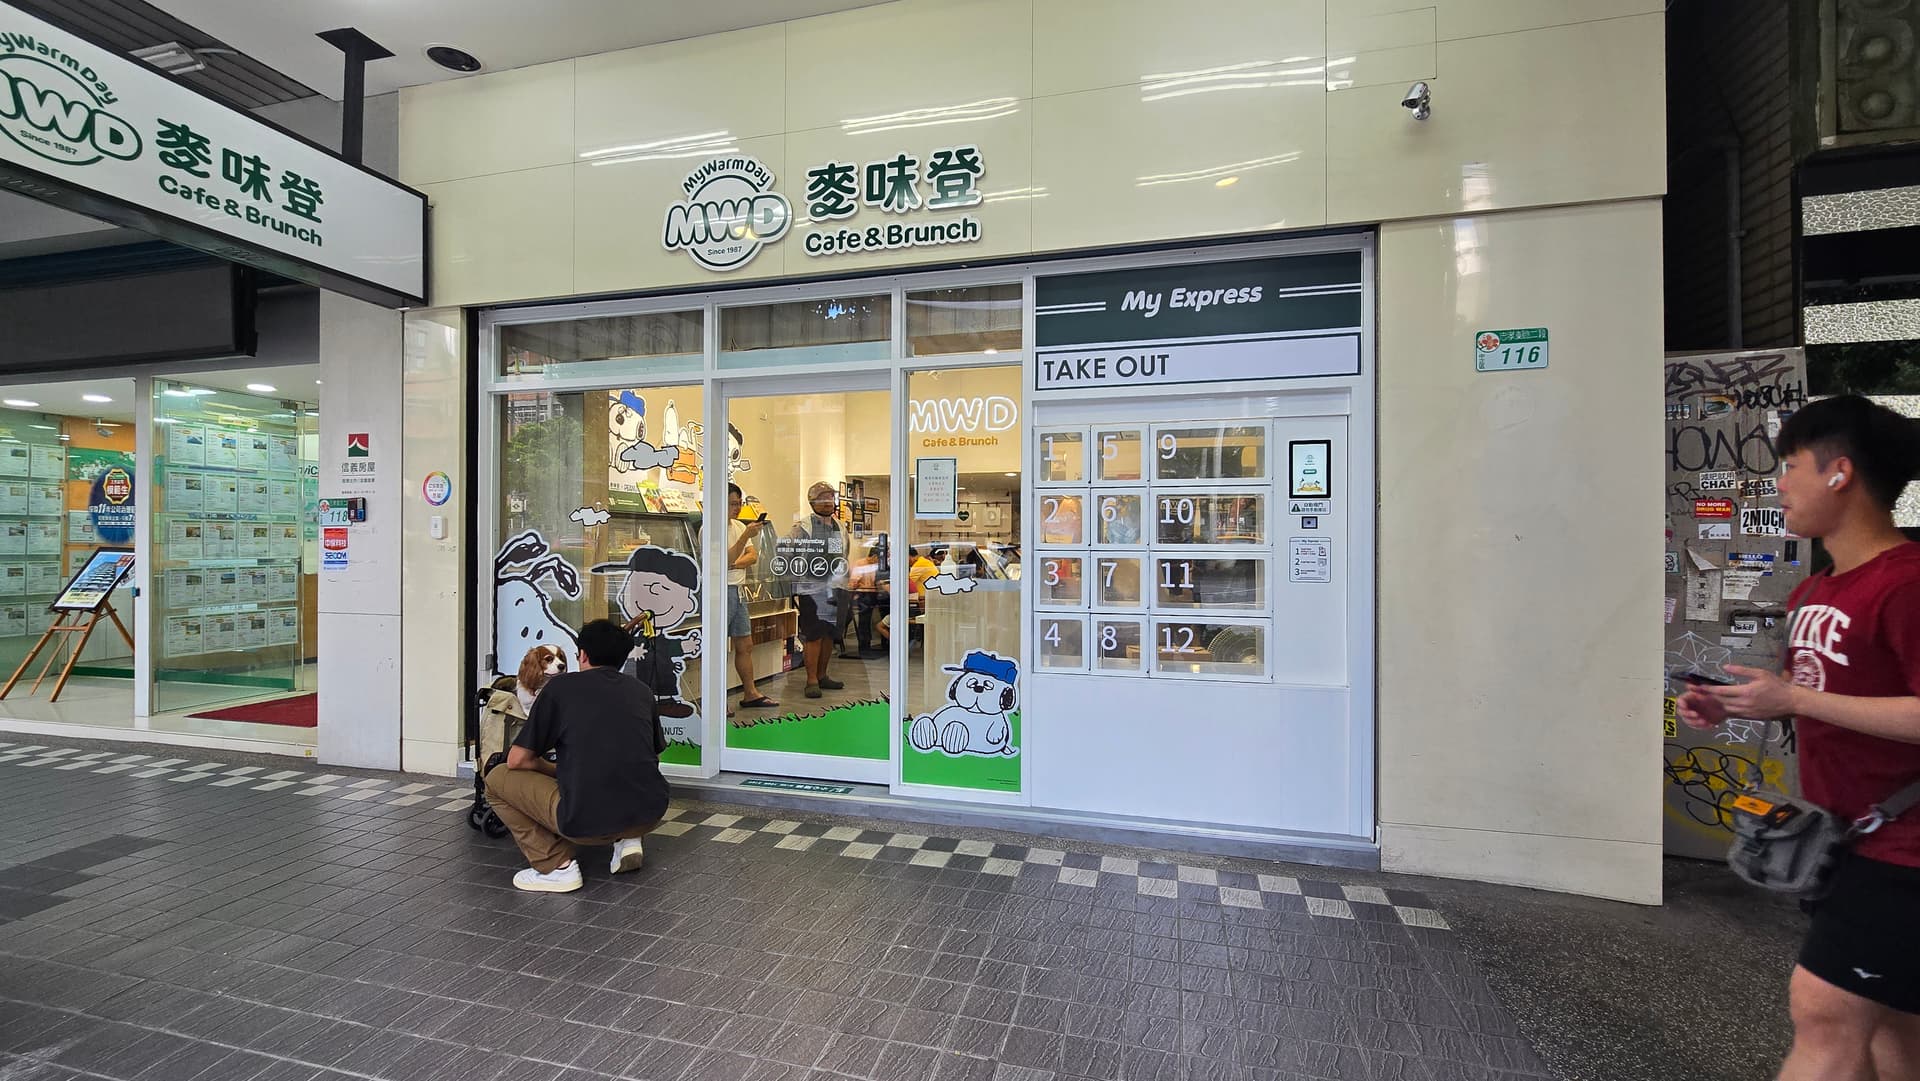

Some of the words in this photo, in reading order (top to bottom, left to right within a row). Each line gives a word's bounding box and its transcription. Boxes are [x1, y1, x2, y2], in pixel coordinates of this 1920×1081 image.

[20, 130, 51, 146] Since
[53, 142, 78, 155] 1987
[156, 118, 324, 224] 麥味登
[808, 147, 982, 217] 麥味登
[664, 194, 789, 248] MWD
[707, 247, 726, 256] Since
[726, 246, 742, 255] 1987
[1121, 290, 1161, 318] My
[1169, 286, 1263, 311] Express
[1043, 357, 1106, 381] TAKE
[1115, 354, 1169, 378] OUT
[1501, 346, 1541, 364] 116
[909, 396, 1017, 432] MWD
[1044, 436, 1057, 461] 1
[1102, 435, 1119, 460] 5
[1160, 434, 1177, 459] 9
[1701, 480, 1734, 489] CHAF
[330, 510, 348, 522] 118
[1044, 498, 1060, 523] 2
[1101, 497, 1117, 522] 6
[1160, 498, 1194, 524] 10
[1742, 509, 1785, 529] 2MUCH
[324, 551, 347, 560] SECOM
[1295, 557, 1300, 566] 2
[1044, 561, 1060, 586] 3
[1101, 562, 1118, 587] 7
[1160, 561, 1194, 588] 11
[1295, 568, 1300, 576] 3
[1044, 625, 1061, 648] 4
[1101, 626, 1118, 650] 8
[1160, 627, 1195, 653] 12
